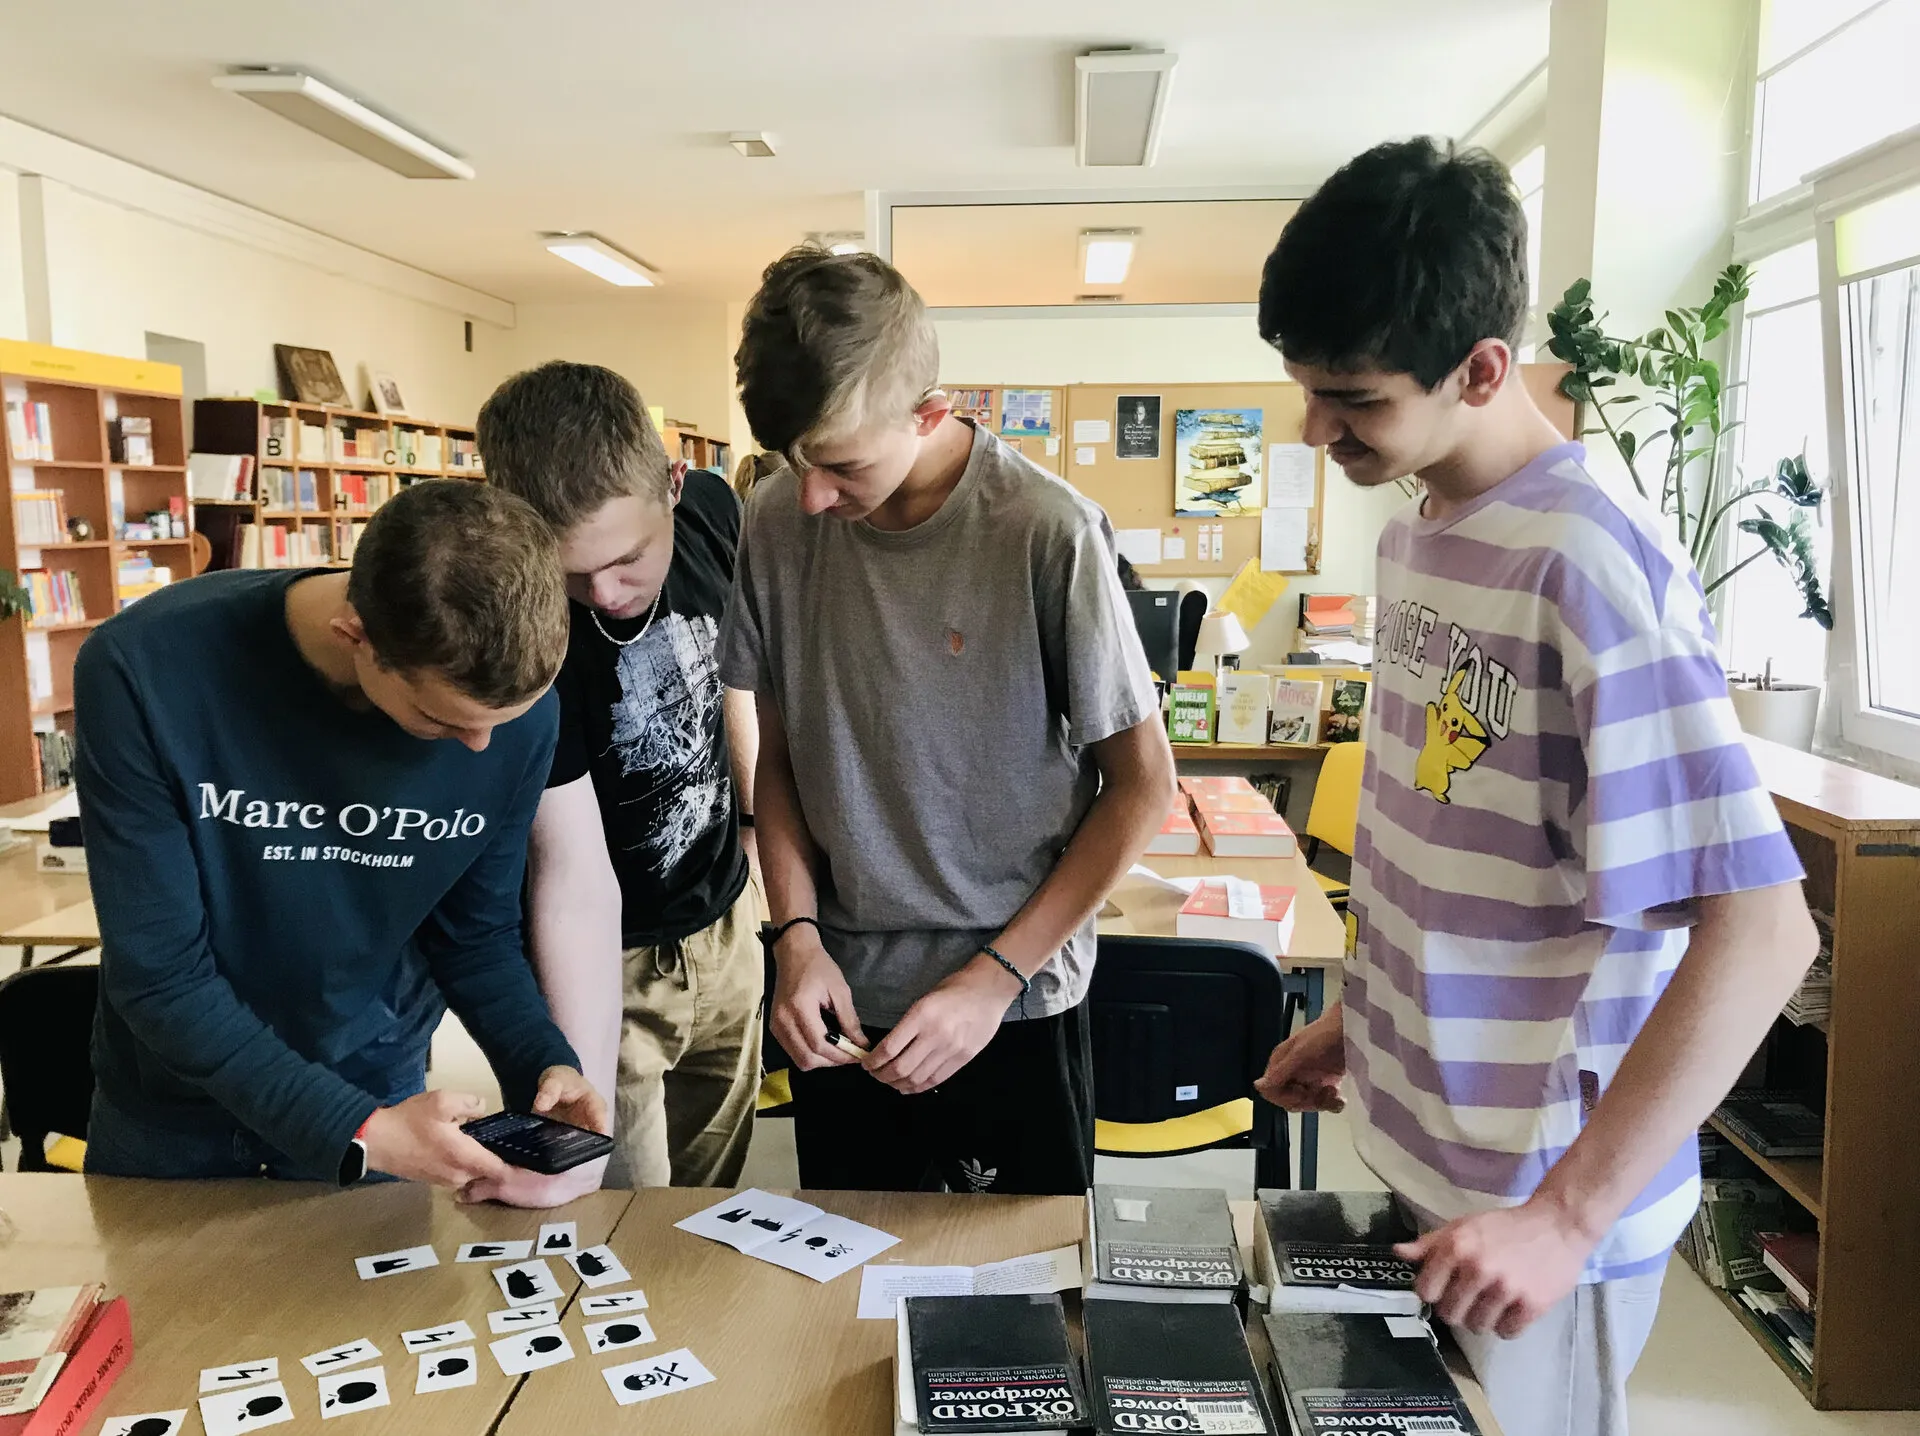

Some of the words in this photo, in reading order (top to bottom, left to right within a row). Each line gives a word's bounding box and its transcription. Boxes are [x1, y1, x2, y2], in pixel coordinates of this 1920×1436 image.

[267, 438, 282, 457] B
[383, 449, 396, 466] C
[334, 493, 348, 511] H
[1440, 622, 1519, 741] YOU
[197, 782, 326, 830] Marc
[337, 801, 487, 842] O'Polo
[262, 845, 296, 862] EST.
[300, 846, 317, 862] IN
[322, 845, 415, 869] STOCKHOLM
[1110, 1256, 1232, 1271] Wordpower
[1290, 1256, 1413, 1271] Wordpower
[1111, 1266, 1235, 1285] OXFORD
[1293, 1266, 1417, 1282] OXFORD
[929, 1386, 1073, 1403] Wordpower
[931, 1399, 1076, 1420] OXFORD
[1111, 1397, 1189, 1412] power
